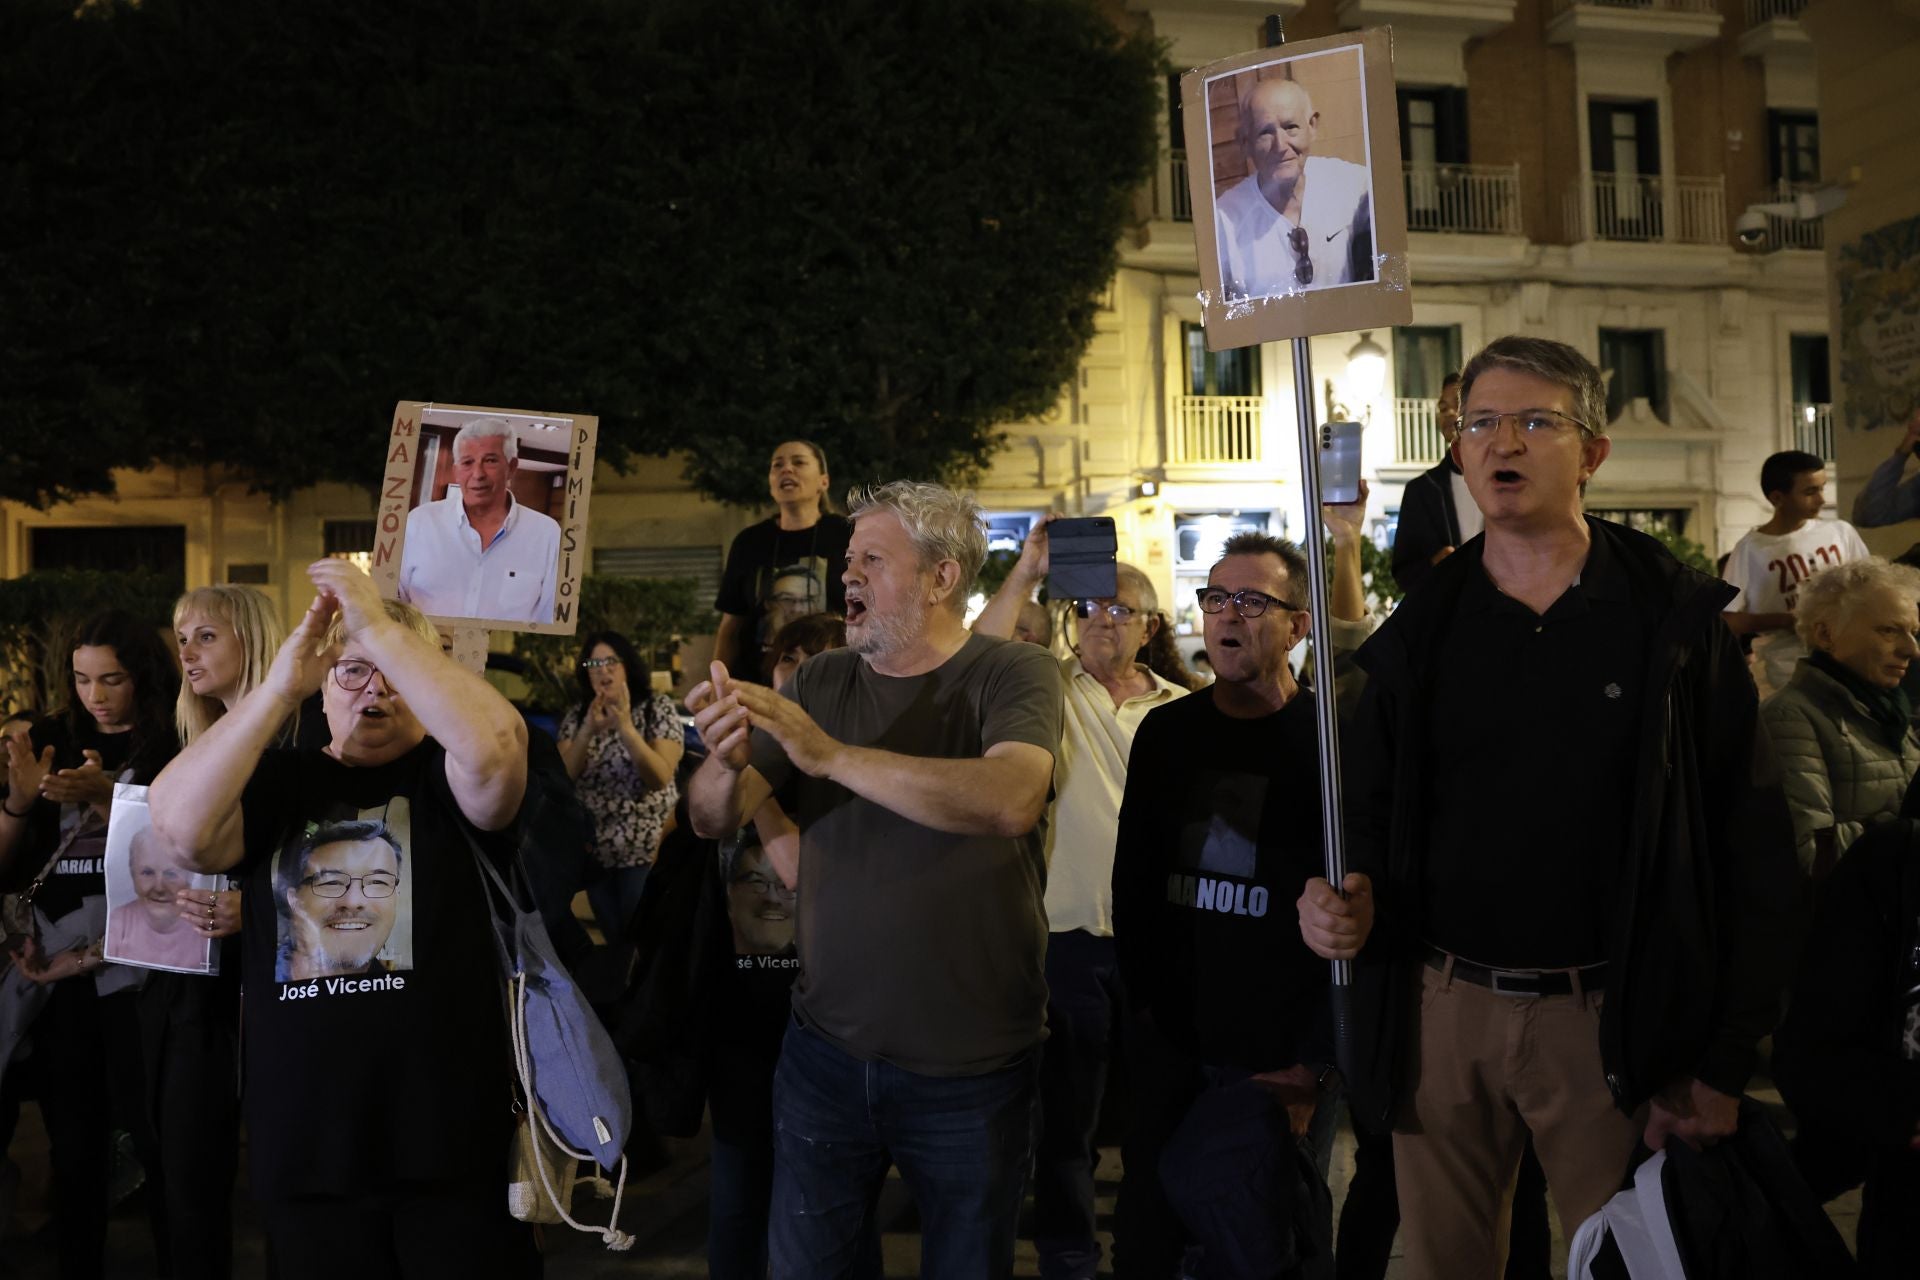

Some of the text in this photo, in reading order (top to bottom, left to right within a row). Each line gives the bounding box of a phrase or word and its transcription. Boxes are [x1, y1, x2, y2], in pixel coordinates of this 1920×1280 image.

[375, 417, 414, 567] MAZÓN
[1167, 871, 1269, 918] MANOLO
[737, 954, 800, 969] sé Vicen
[279, 973, 405, 1001] José Vicente
